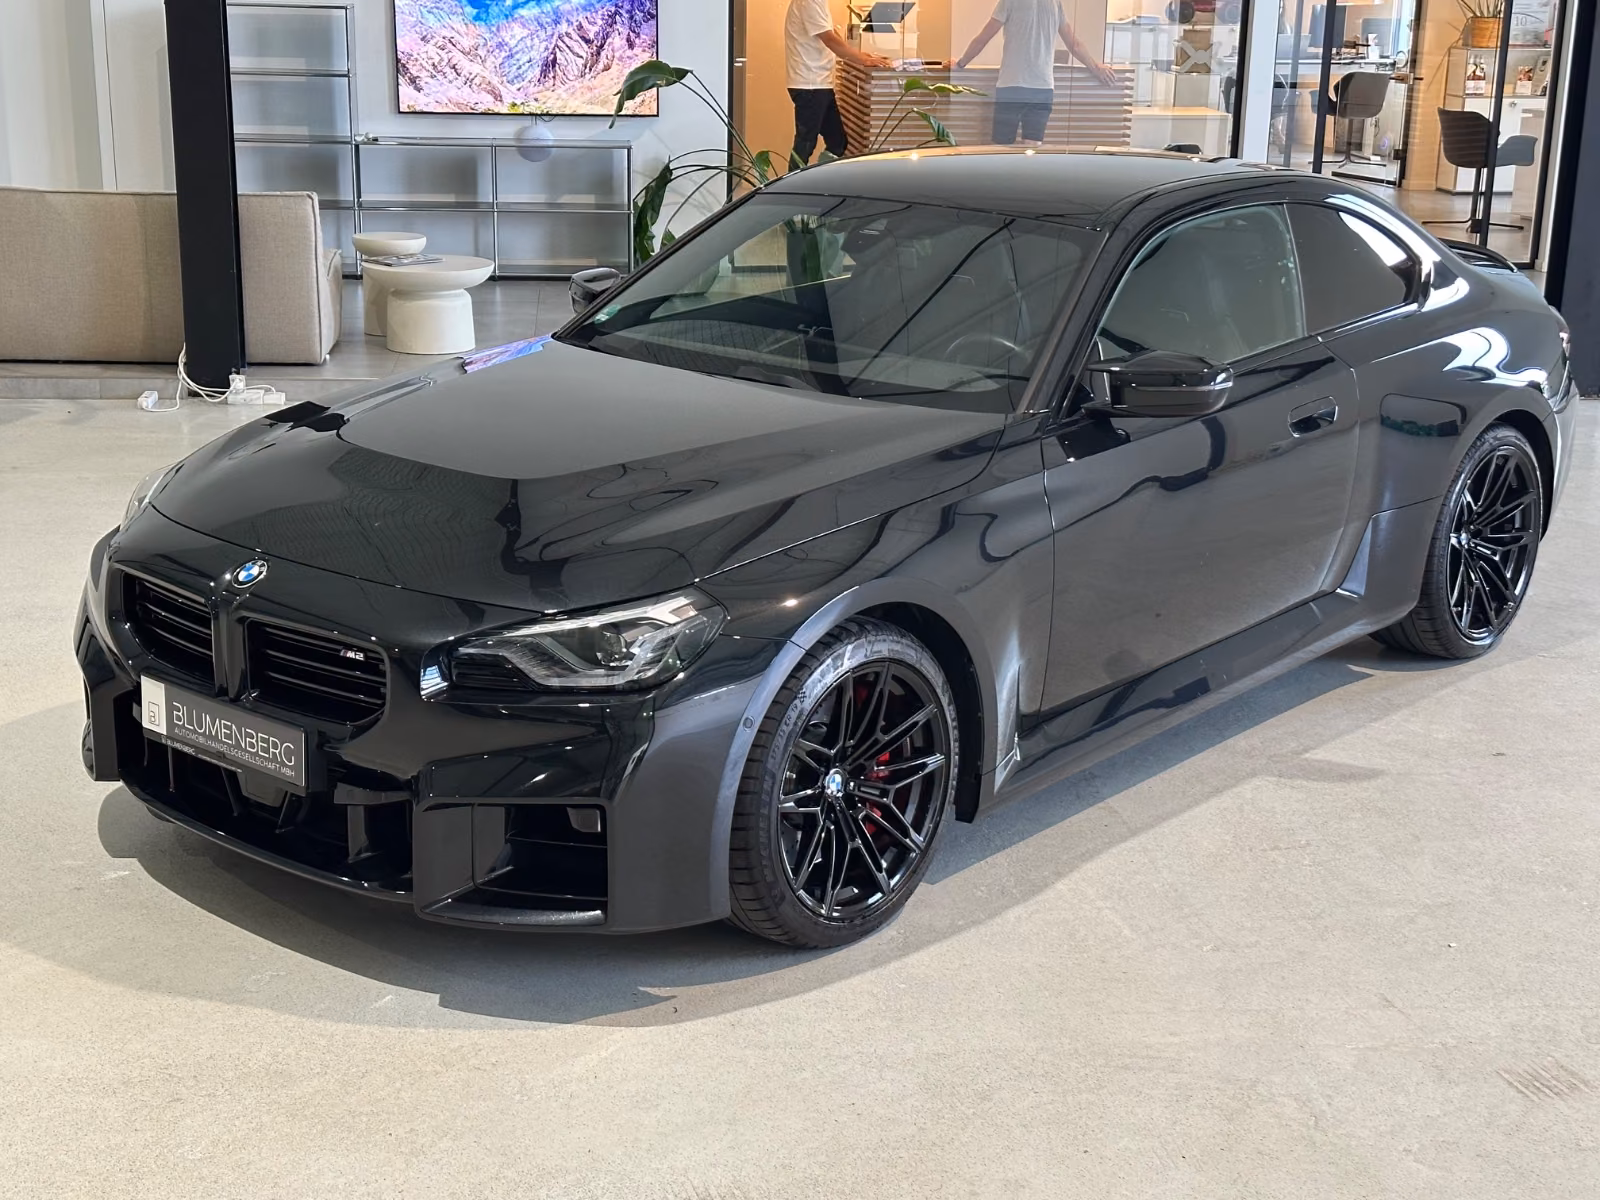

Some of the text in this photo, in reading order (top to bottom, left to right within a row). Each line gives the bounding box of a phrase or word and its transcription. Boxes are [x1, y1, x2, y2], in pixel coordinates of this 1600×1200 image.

[172, 701, 295, 766] BLUMENBERG
[174, 727, 280, 772] AUTOMOBILHANDELSGESELLSCHAFT
[280, 766, 295, 777] MBH
